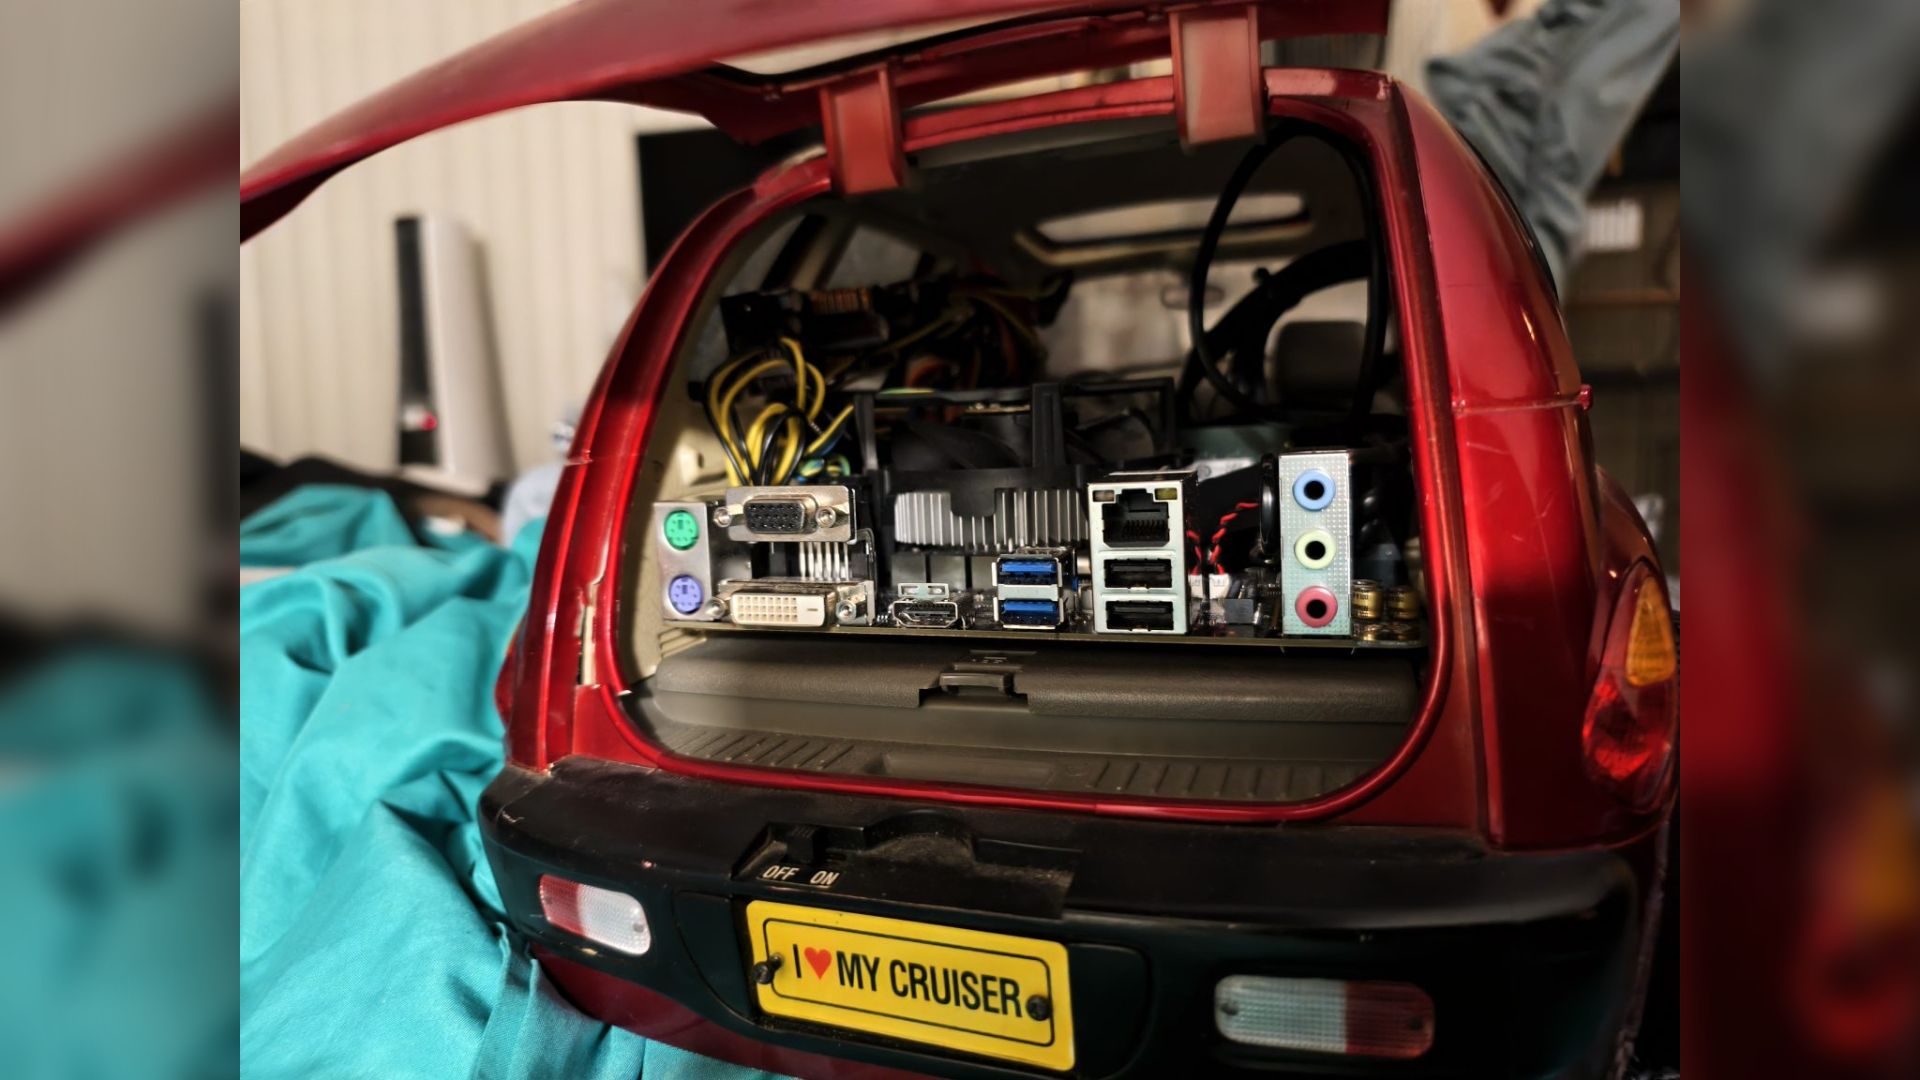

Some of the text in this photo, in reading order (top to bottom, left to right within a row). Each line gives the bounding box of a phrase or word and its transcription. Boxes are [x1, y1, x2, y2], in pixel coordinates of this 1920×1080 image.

[762, 865, 840, 885] OFF ON
[793, 944, 1021, 1018] I MY CRUISER
